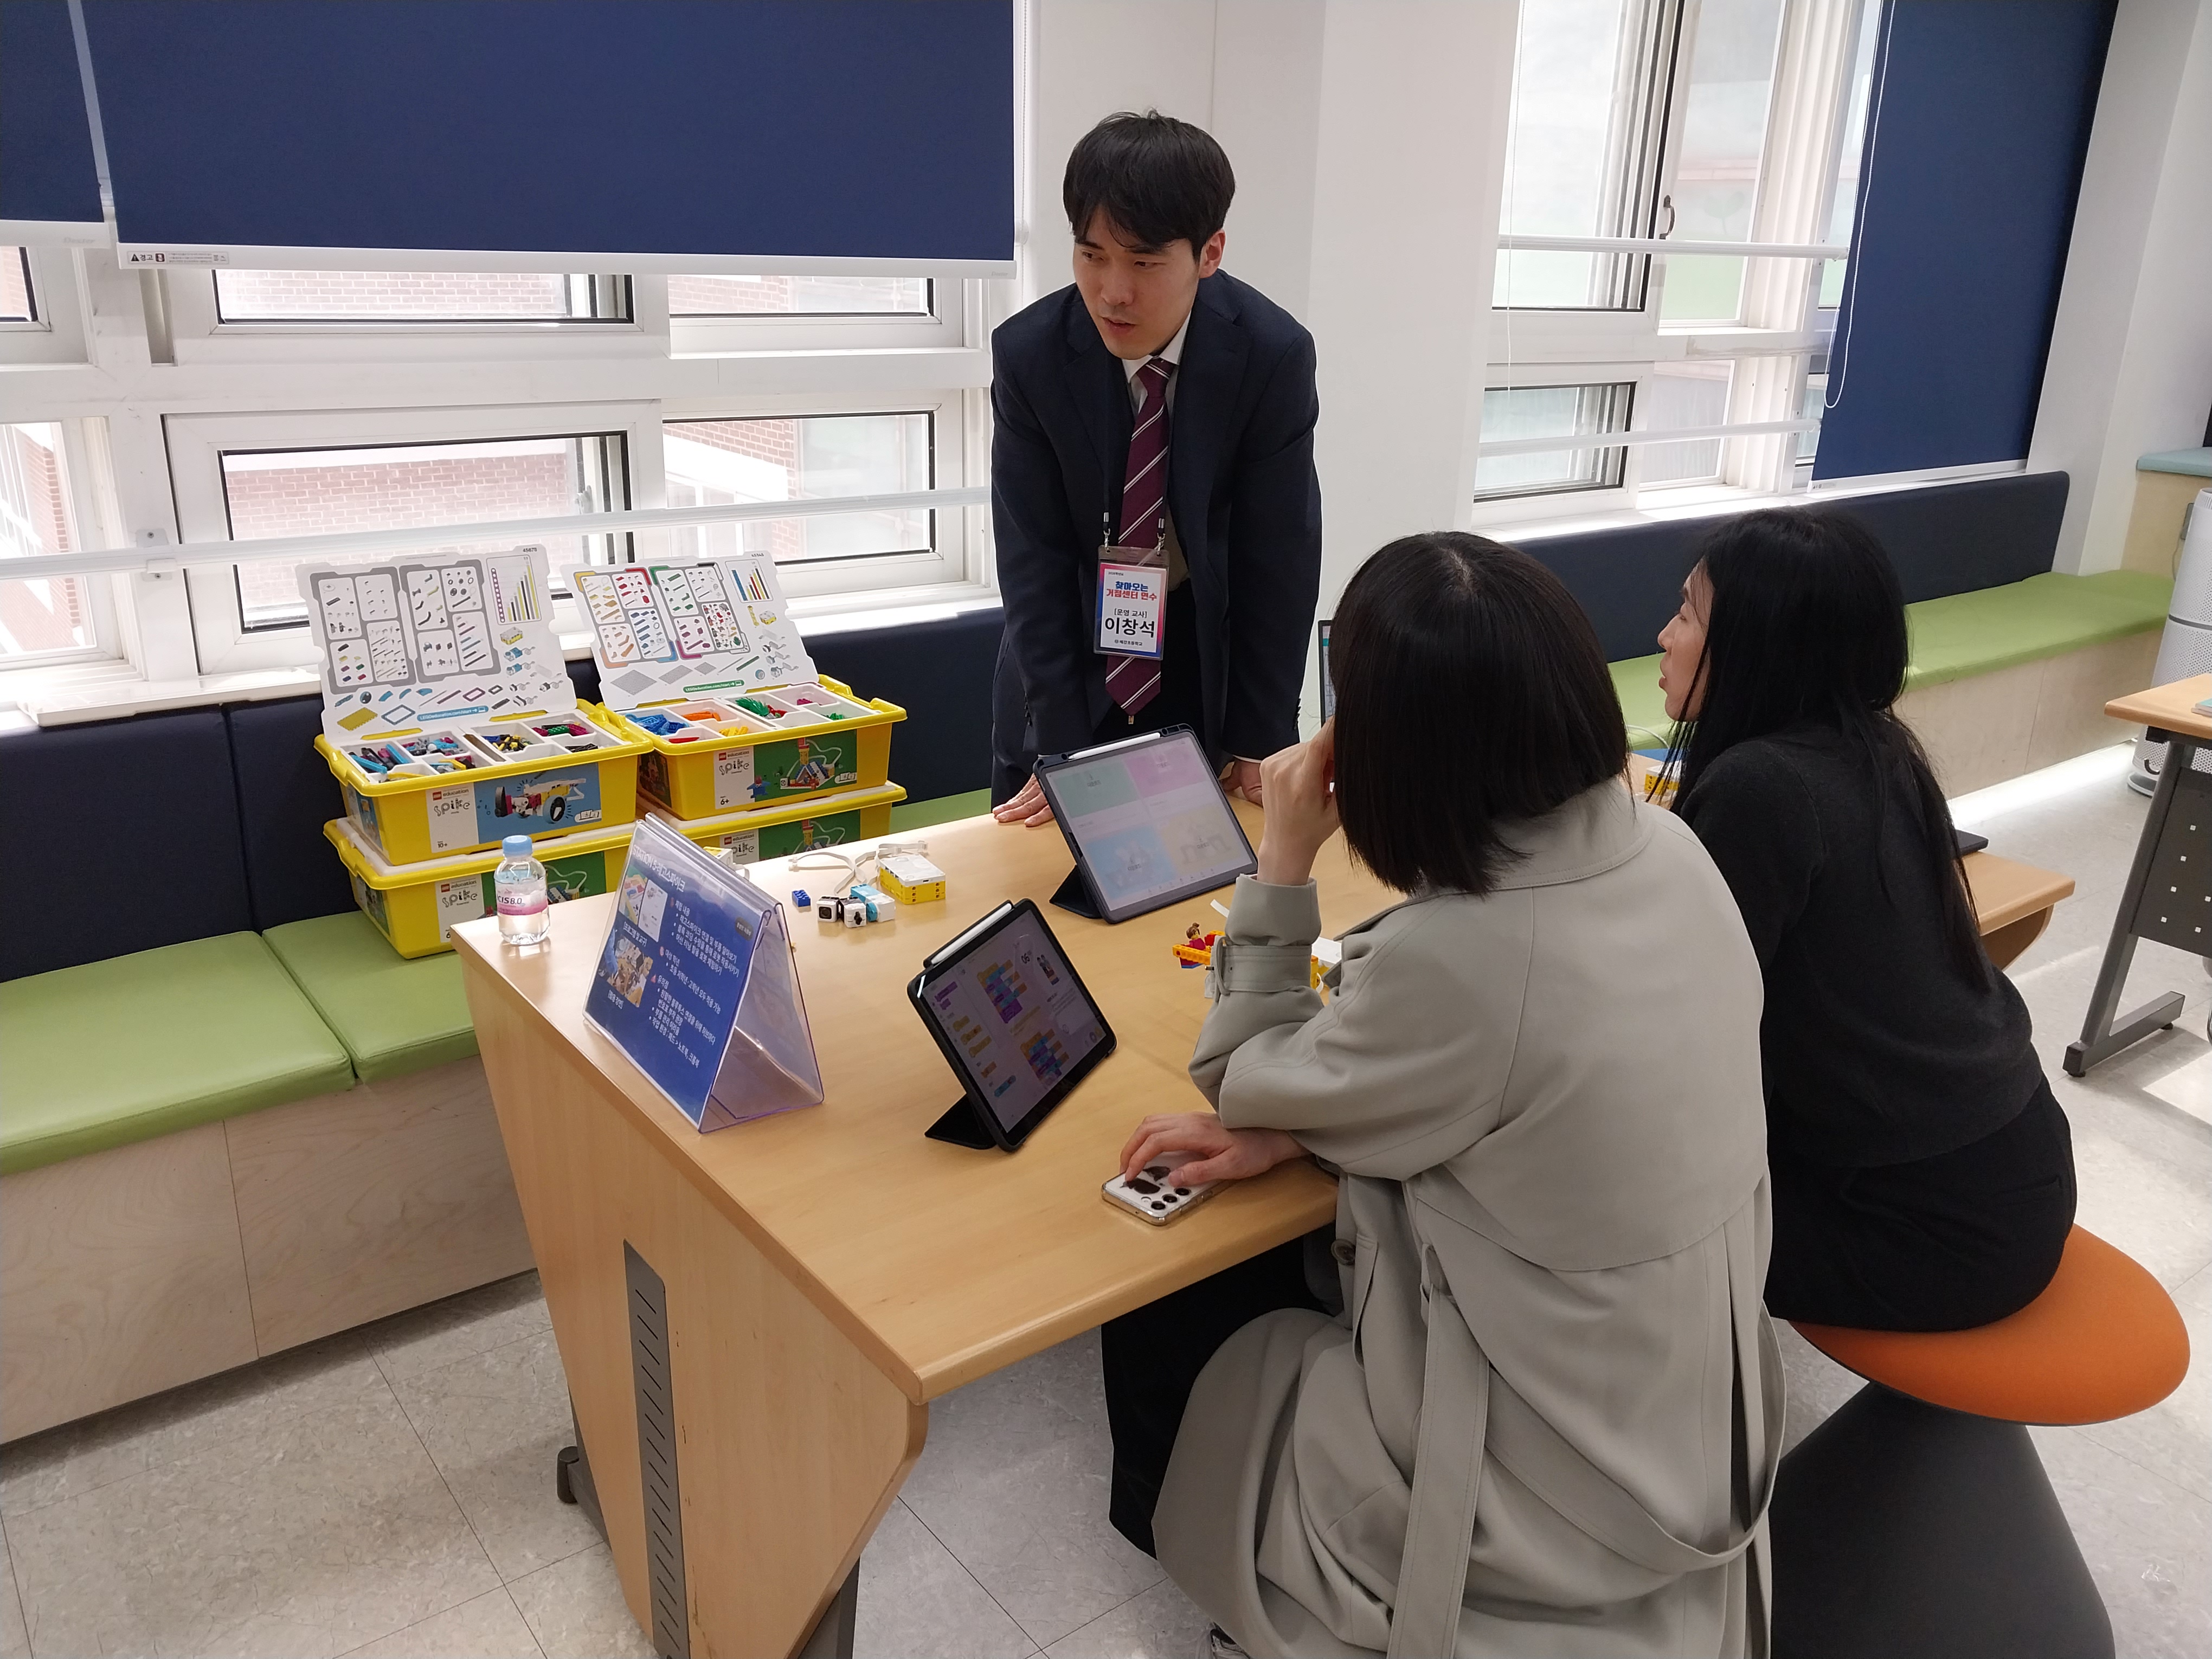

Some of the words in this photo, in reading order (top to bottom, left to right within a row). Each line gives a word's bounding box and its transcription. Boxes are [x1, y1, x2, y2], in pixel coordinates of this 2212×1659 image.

[1107, 589, 1138, 599] 거점센터
[1141, 592, 1157, 601] 연수
[1115, 581, 1148, 592] 찾아오는
[1105, 617, 1155, 638] 이창석
[443, 789, 469, 797] education
[633, 845, 654, 867] STATION
[451, 880, 477, 889] education
[497, 895, 509, 904] CIS
[683, 906, 690, 916] 내용
[680, 915, 701, 936] 레고스파이크
[702, 931, 709, 942] 연결
[710, 936, 714, 946] 및
[714, 940, 722, 952] 부품
[722, 946, 737, 964] 알아보기
[685, 930, 693, 941] 코딩
[712, 950, 721, 962] 로봇
[665, 949, 672, 960] 대상
[672, 955, 680, 967] 학년
[699, 951, 707, 963] 로봇
[657, 975, 670, 989] 유의점
[670, 964, 677, 975] 초등
[699, 990, 706, 1001] 모두
[706, 995, 713, 1008] 적용
[713, 1002, 721, 1014] 가능
[655, 1008, 663, 1020] 부품
[662, 1014, 670, 1026] 관리
[669, 1021, 680, 1036] 어려움
[660, 989, 672, 1004] 원활한
[684, 1010, 696, 1026] 연결을
[695, 1020, 703, 1032] 위해
[702, 1027, 716, 1045] 허브마다
[668, 1008, 676, 1020] 부착
[675, 1014, 683, 1026] 권장
[652, 1017, 660, 1030] 작업
[659, 1024, 667, 1036] 환경
[668, 1033, 676, 1044] 패드
[689, 1052, 700, 1069] 크롬북
